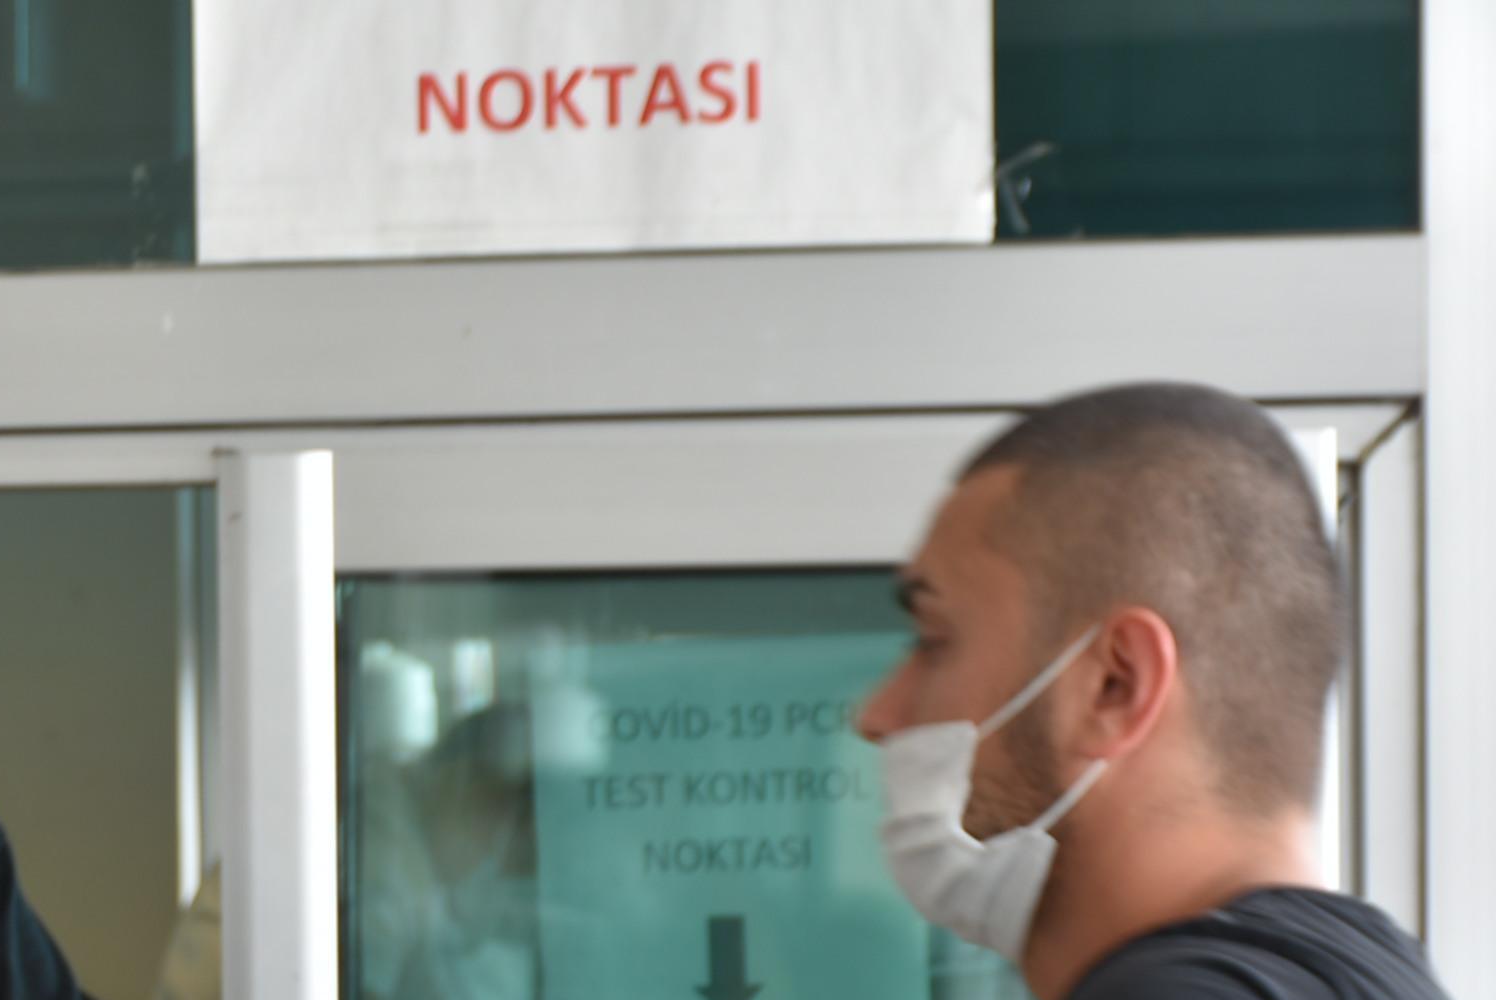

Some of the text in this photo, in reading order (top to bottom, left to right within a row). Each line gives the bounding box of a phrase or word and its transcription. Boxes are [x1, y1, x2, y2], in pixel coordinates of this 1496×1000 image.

[417, 60, 760, 134] NOKTASI
[582, 766, 871, 810] TEST KONTROL
[642, 834, 812, 874] NOKTASI
